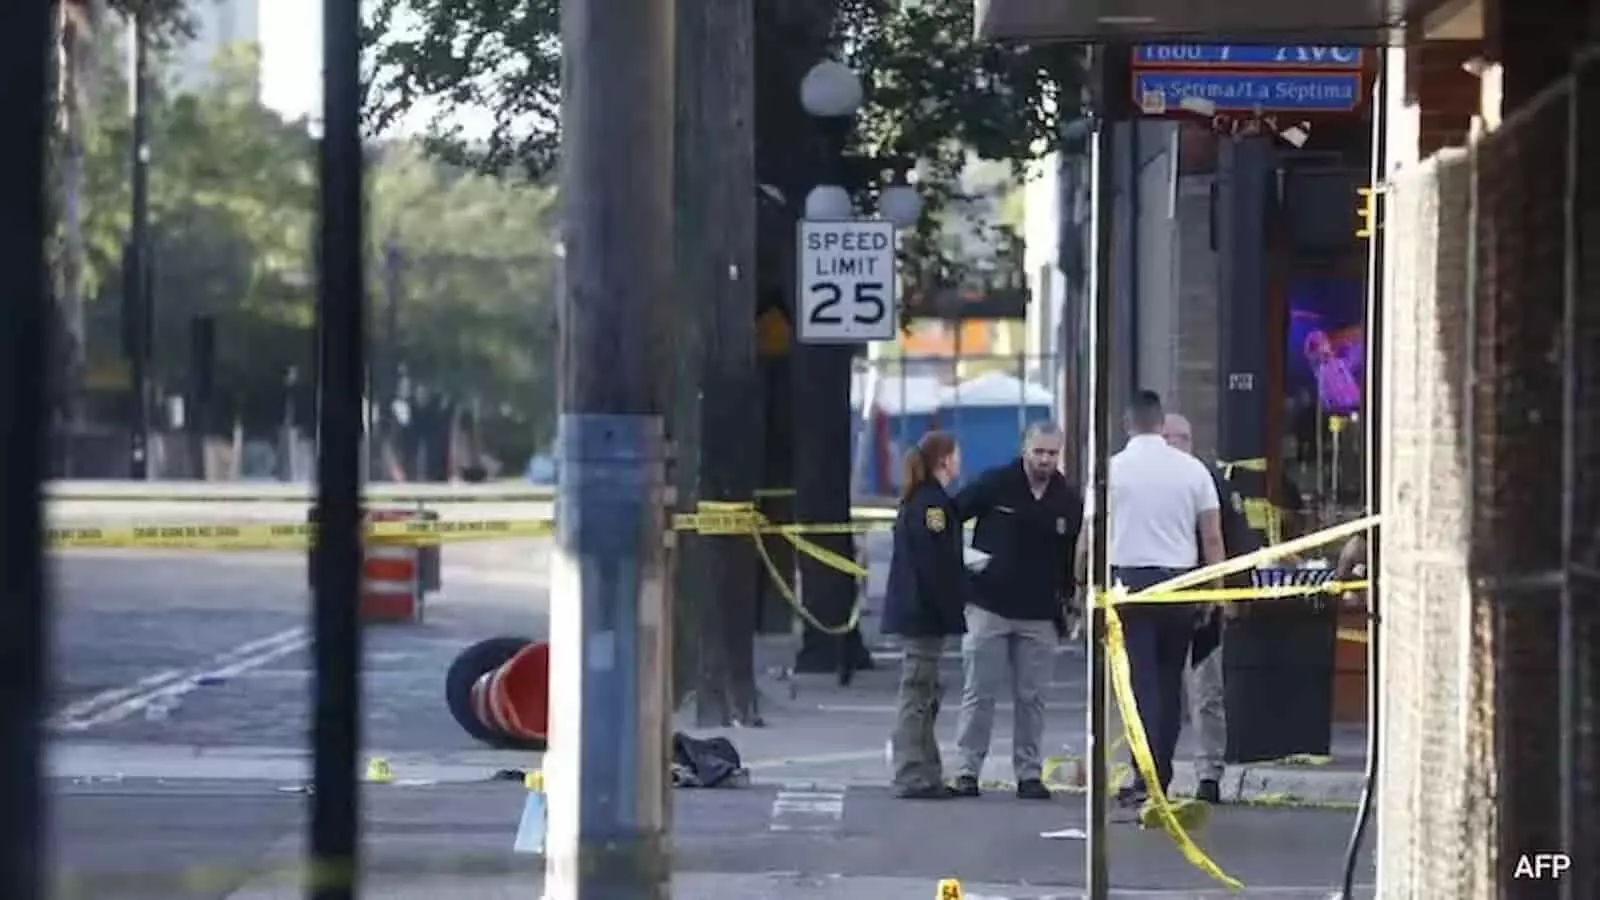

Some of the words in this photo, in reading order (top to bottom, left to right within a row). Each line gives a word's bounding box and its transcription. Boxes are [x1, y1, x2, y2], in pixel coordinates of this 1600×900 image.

[807, 232, 888, 250] SPEED
[815, 257, 879, 275] LIMIT
[809, 281, 885, 325] 25
